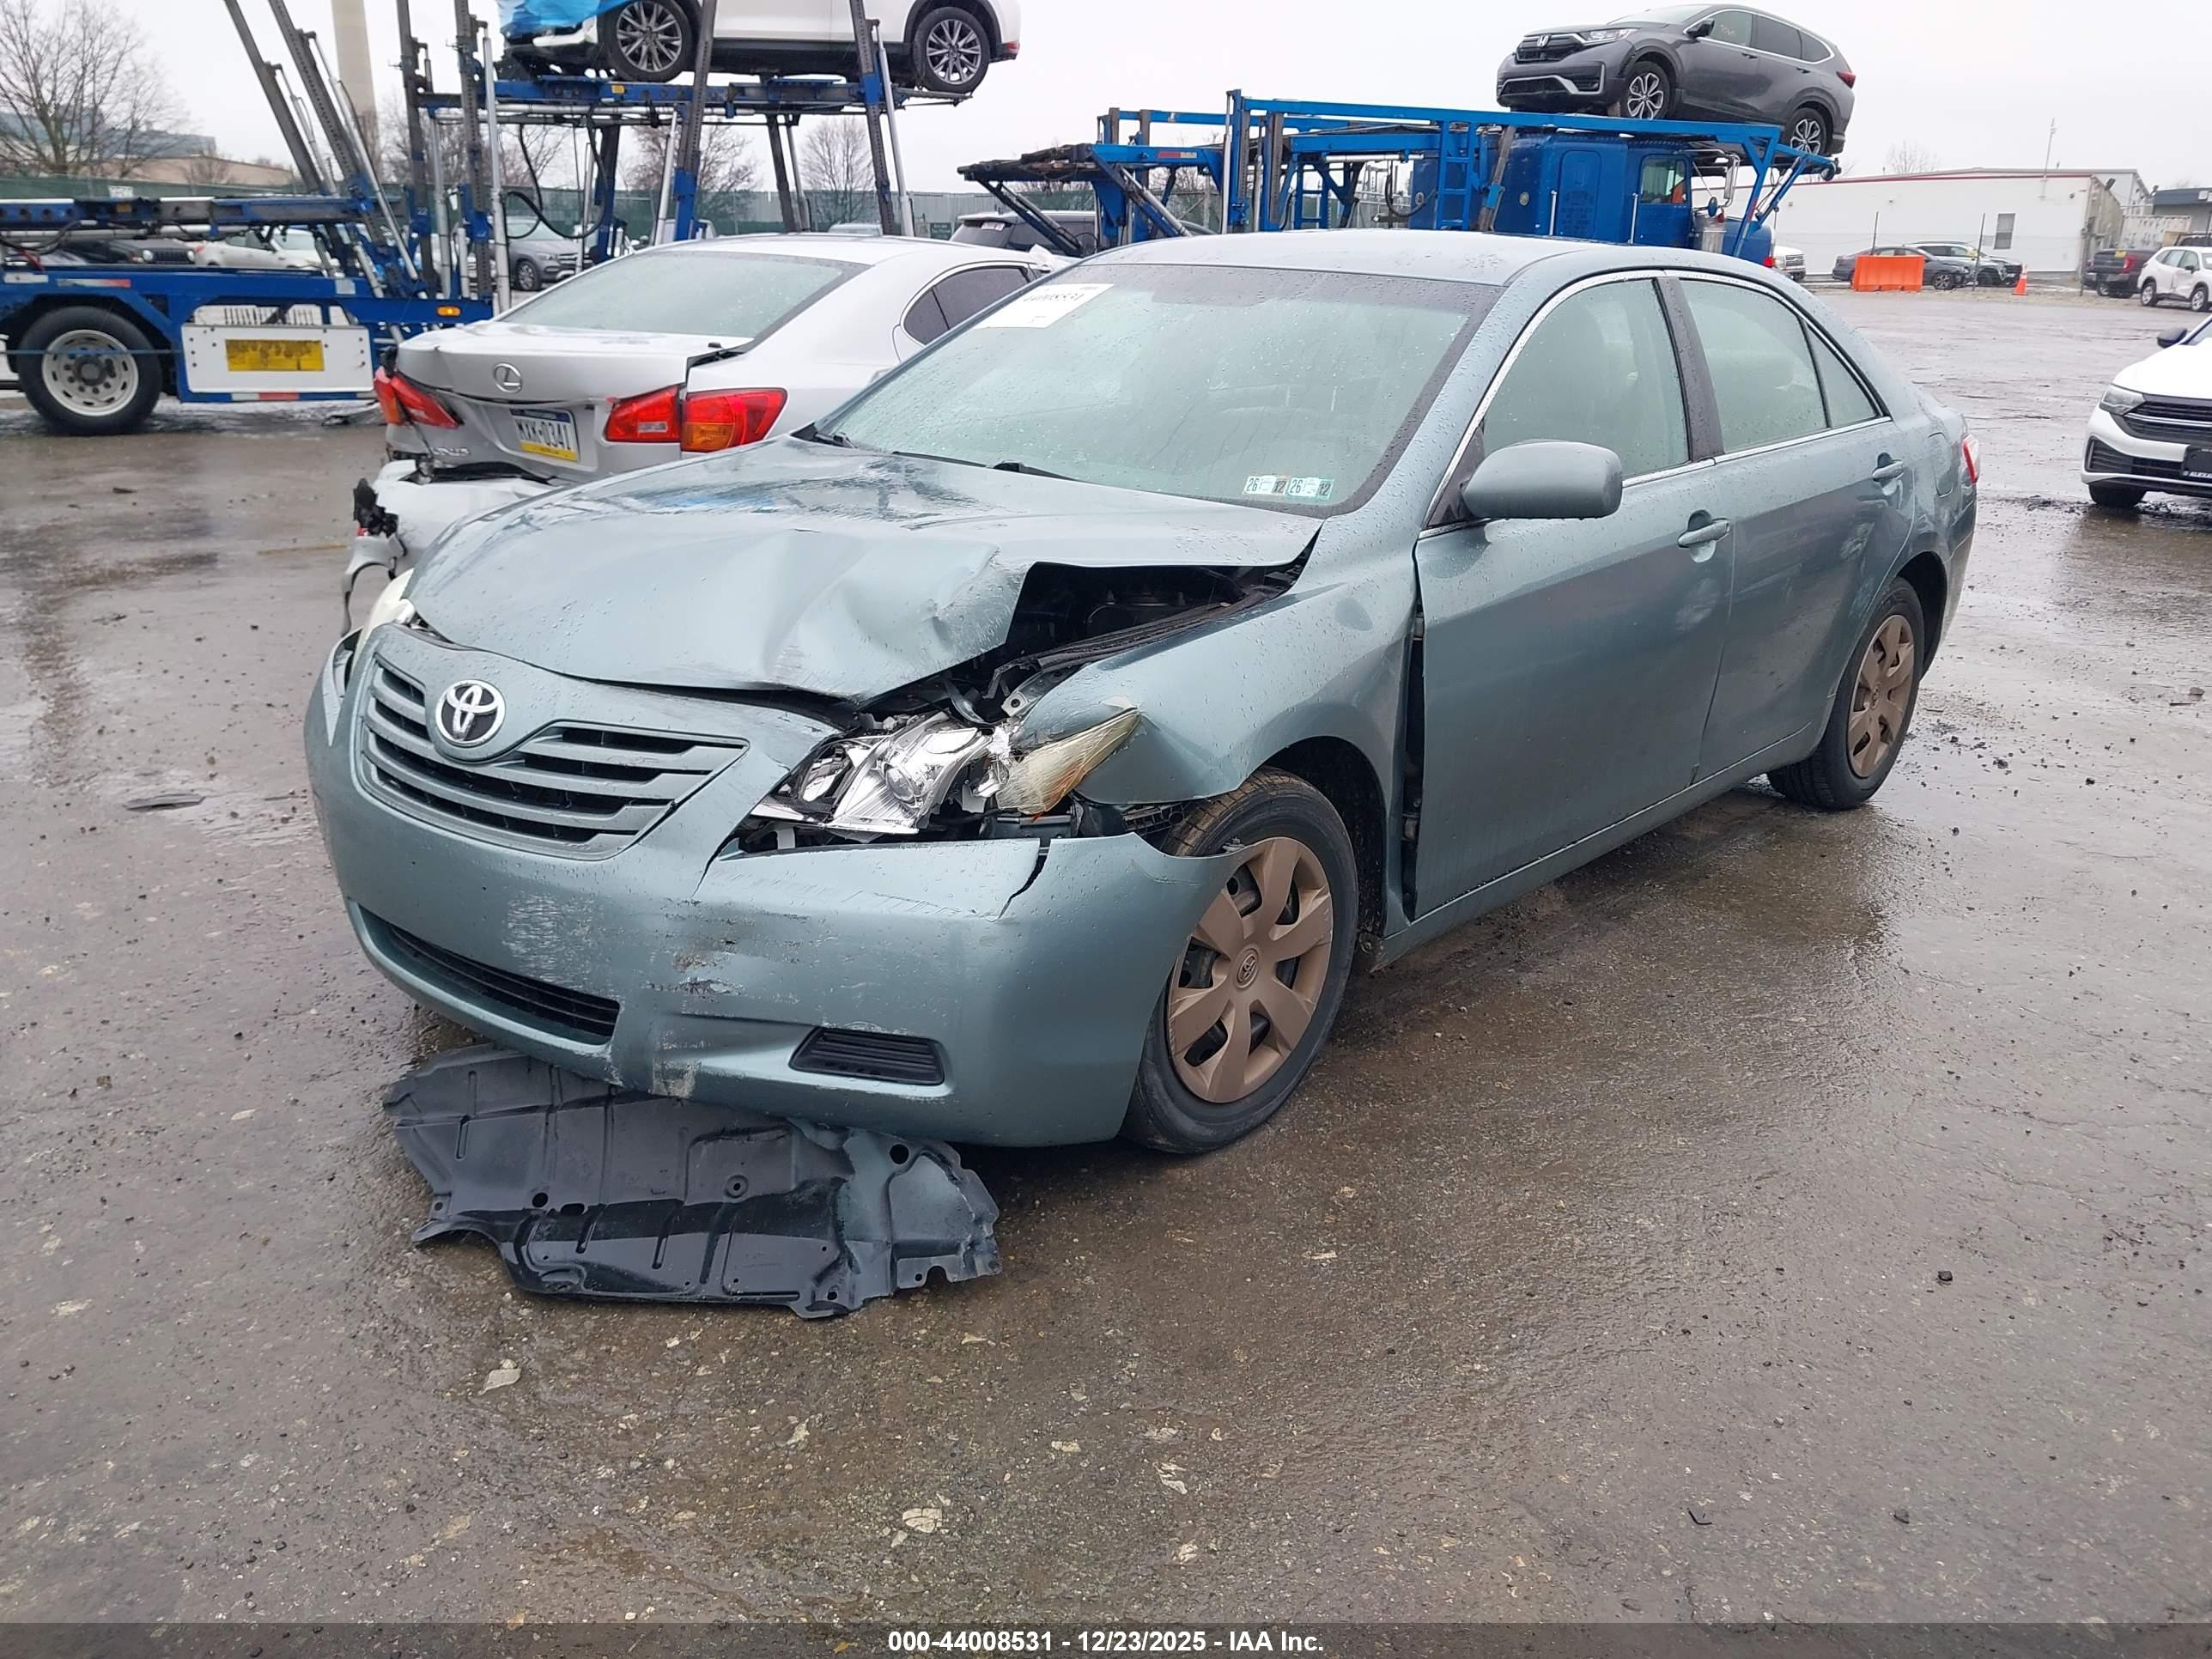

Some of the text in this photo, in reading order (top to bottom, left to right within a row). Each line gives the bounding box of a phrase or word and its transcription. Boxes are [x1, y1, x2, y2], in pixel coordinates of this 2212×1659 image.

[1246, 477, 1259, 492] 26
[1273, 480, 1286, 494] 12
[1290, 479, 1304, 494] 26
[1319, 482, 1331, 496] 12
